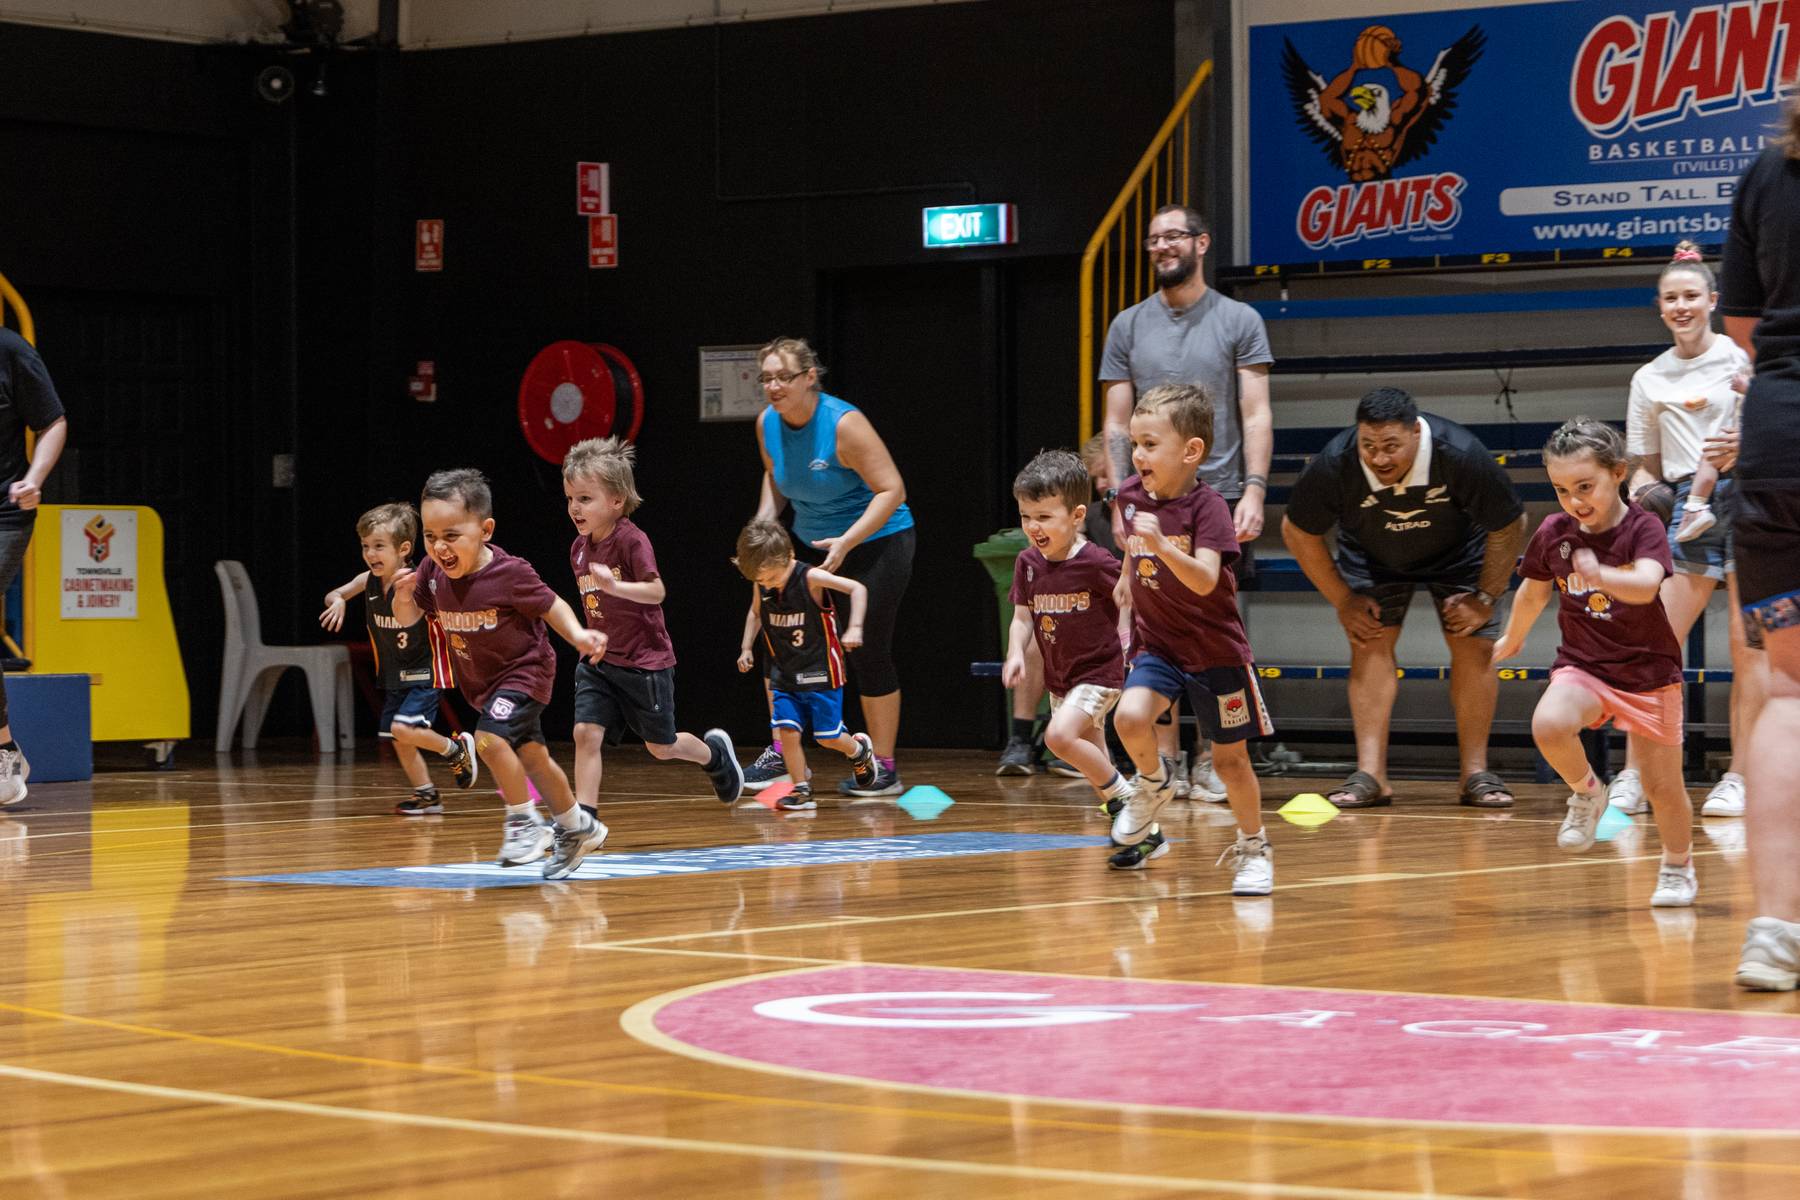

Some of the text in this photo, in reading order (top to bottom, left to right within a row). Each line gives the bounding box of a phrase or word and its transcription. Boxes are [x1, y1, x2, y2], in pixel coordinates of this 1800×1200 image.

[1673, 158, 1735, 175] (TVILLE)
[1297, 172, 1468, 250] GIANTS
[940, 211, 984, 240] EXIT
[1480, 252, 1511, 264] F3
[1602, 247, 1633, 259] F4
[1254, 265, 1280, 276] F1
[1362, 258, 1392, 270] F2
[1385, 520, 1431, 531] ALTRAD
[76, 567, 122, 575] TOWNSVILLE
[64, 578, 134, 592] CABINETMAKING
[77, 594, 120, 608] & JOINERY
[1033, 591, 1090, 614] HOOPS
[438, 608, 498, 632] HOOPS
[769, 612, 806, 627] MIAMI
[396, 631, 409, 650] 3
[792, 629, 805, 647] 3
[1498, 668, 1528, 680] 61
